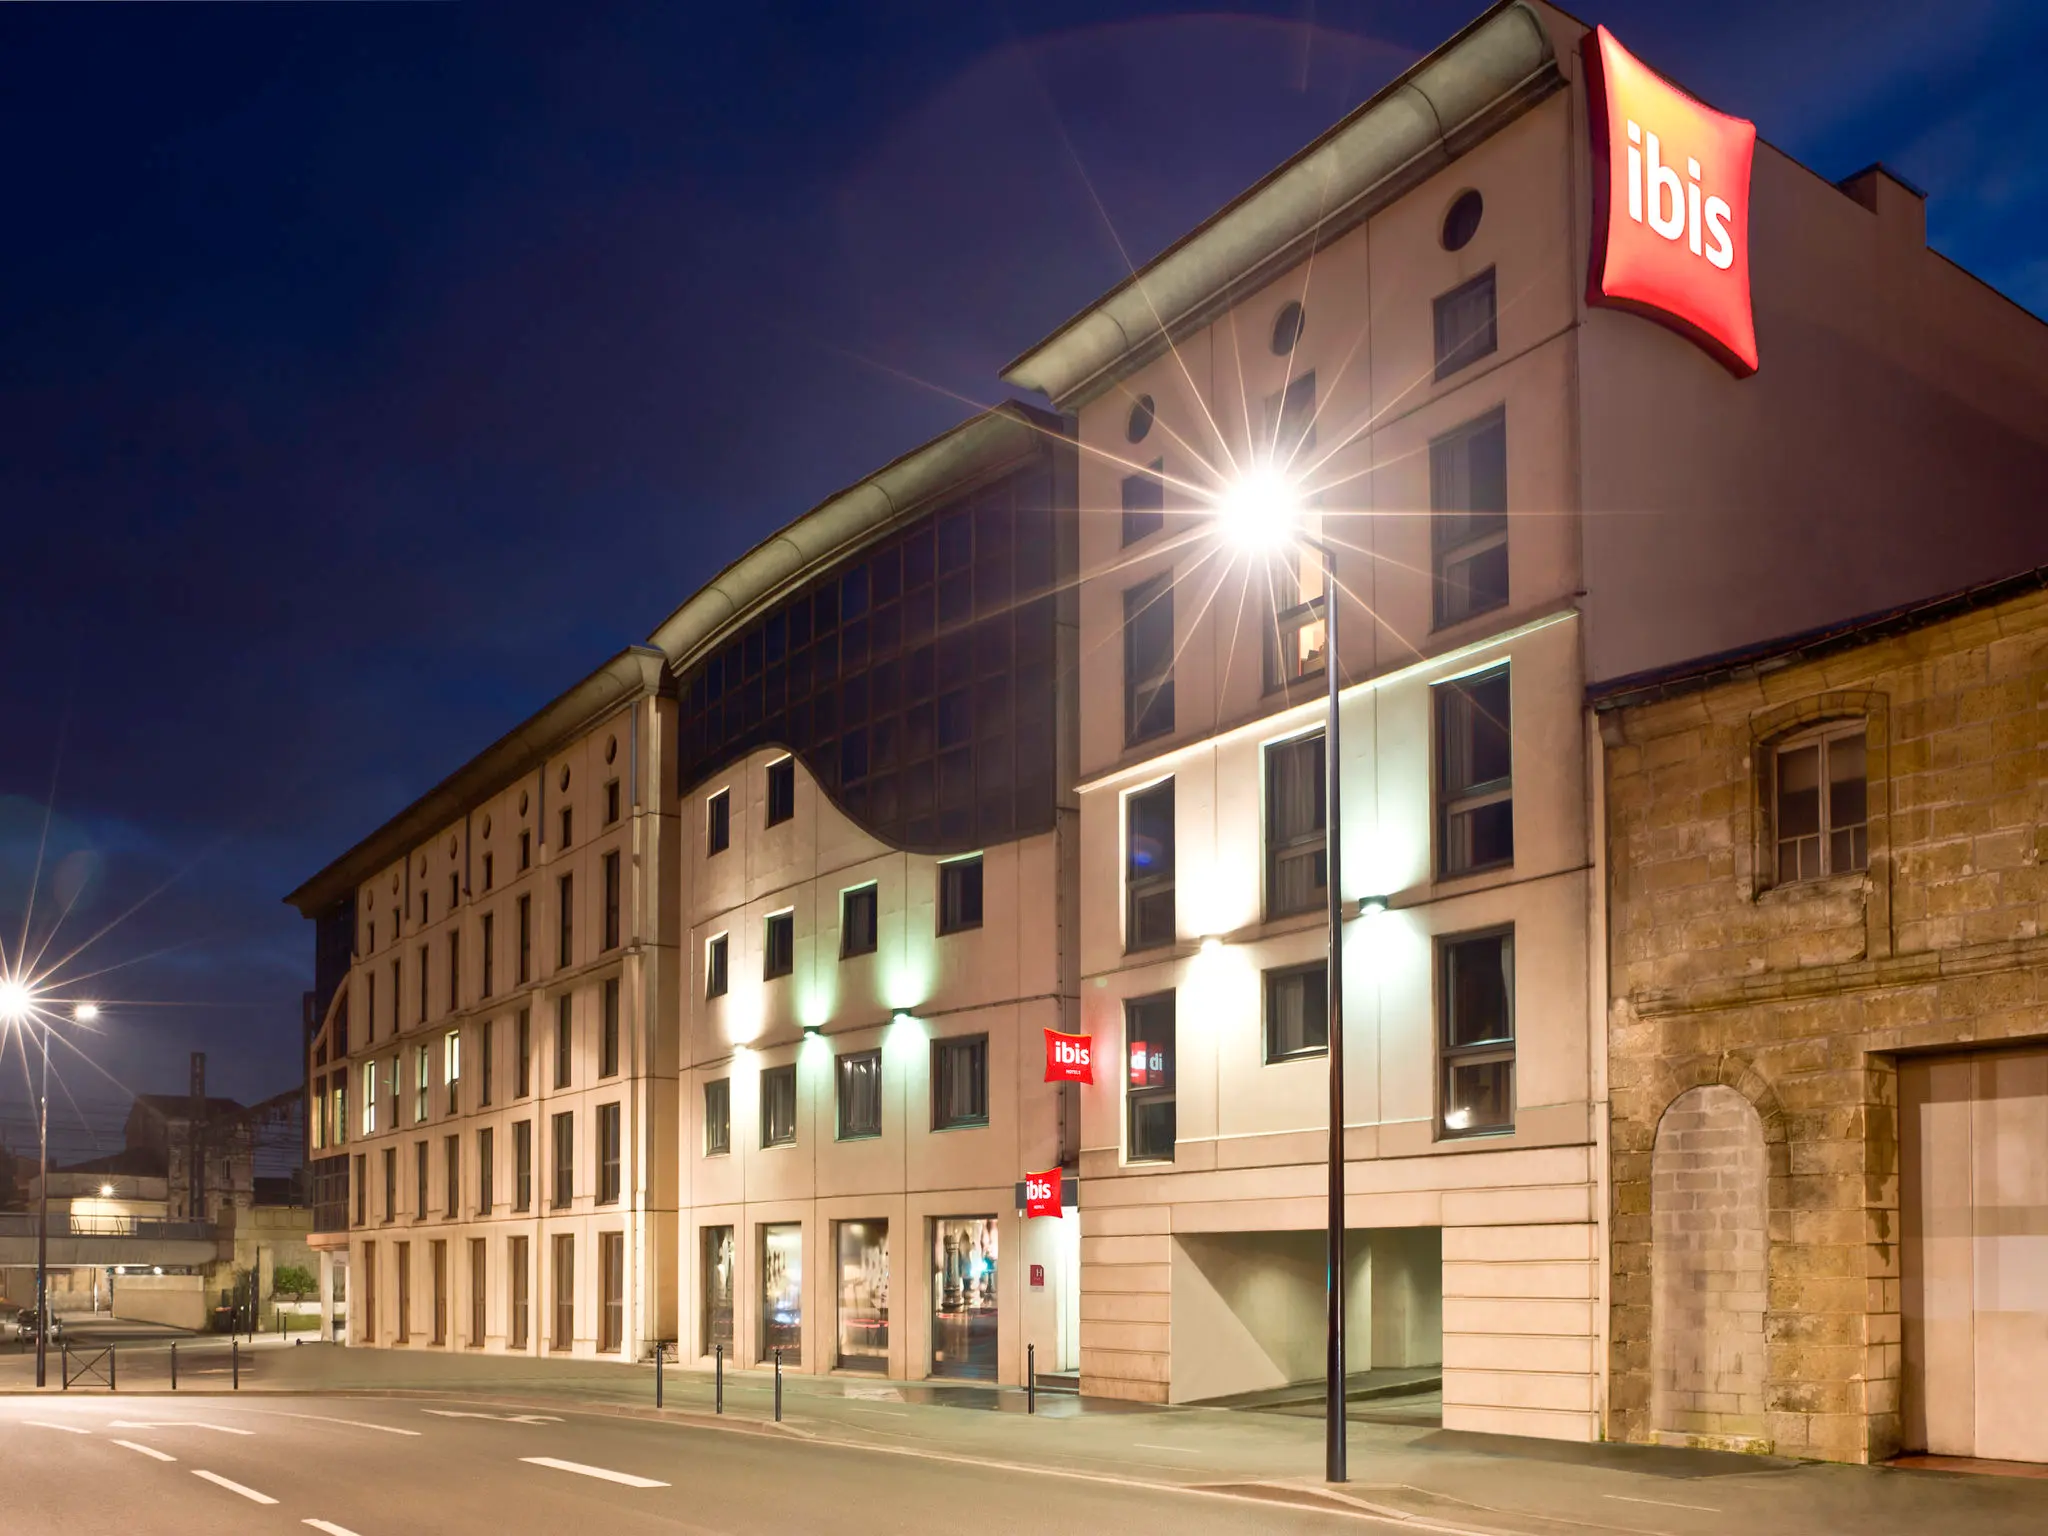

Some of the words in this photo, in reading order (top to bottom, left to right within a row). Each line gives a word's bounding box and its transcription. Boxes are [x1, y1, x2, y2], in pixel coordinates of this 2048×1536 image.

[1627, 119, 1734, 270] ibis
[1055, 1041, 1090, 1065] ibis
[1026, 1179, 1052, 1200] ibis
